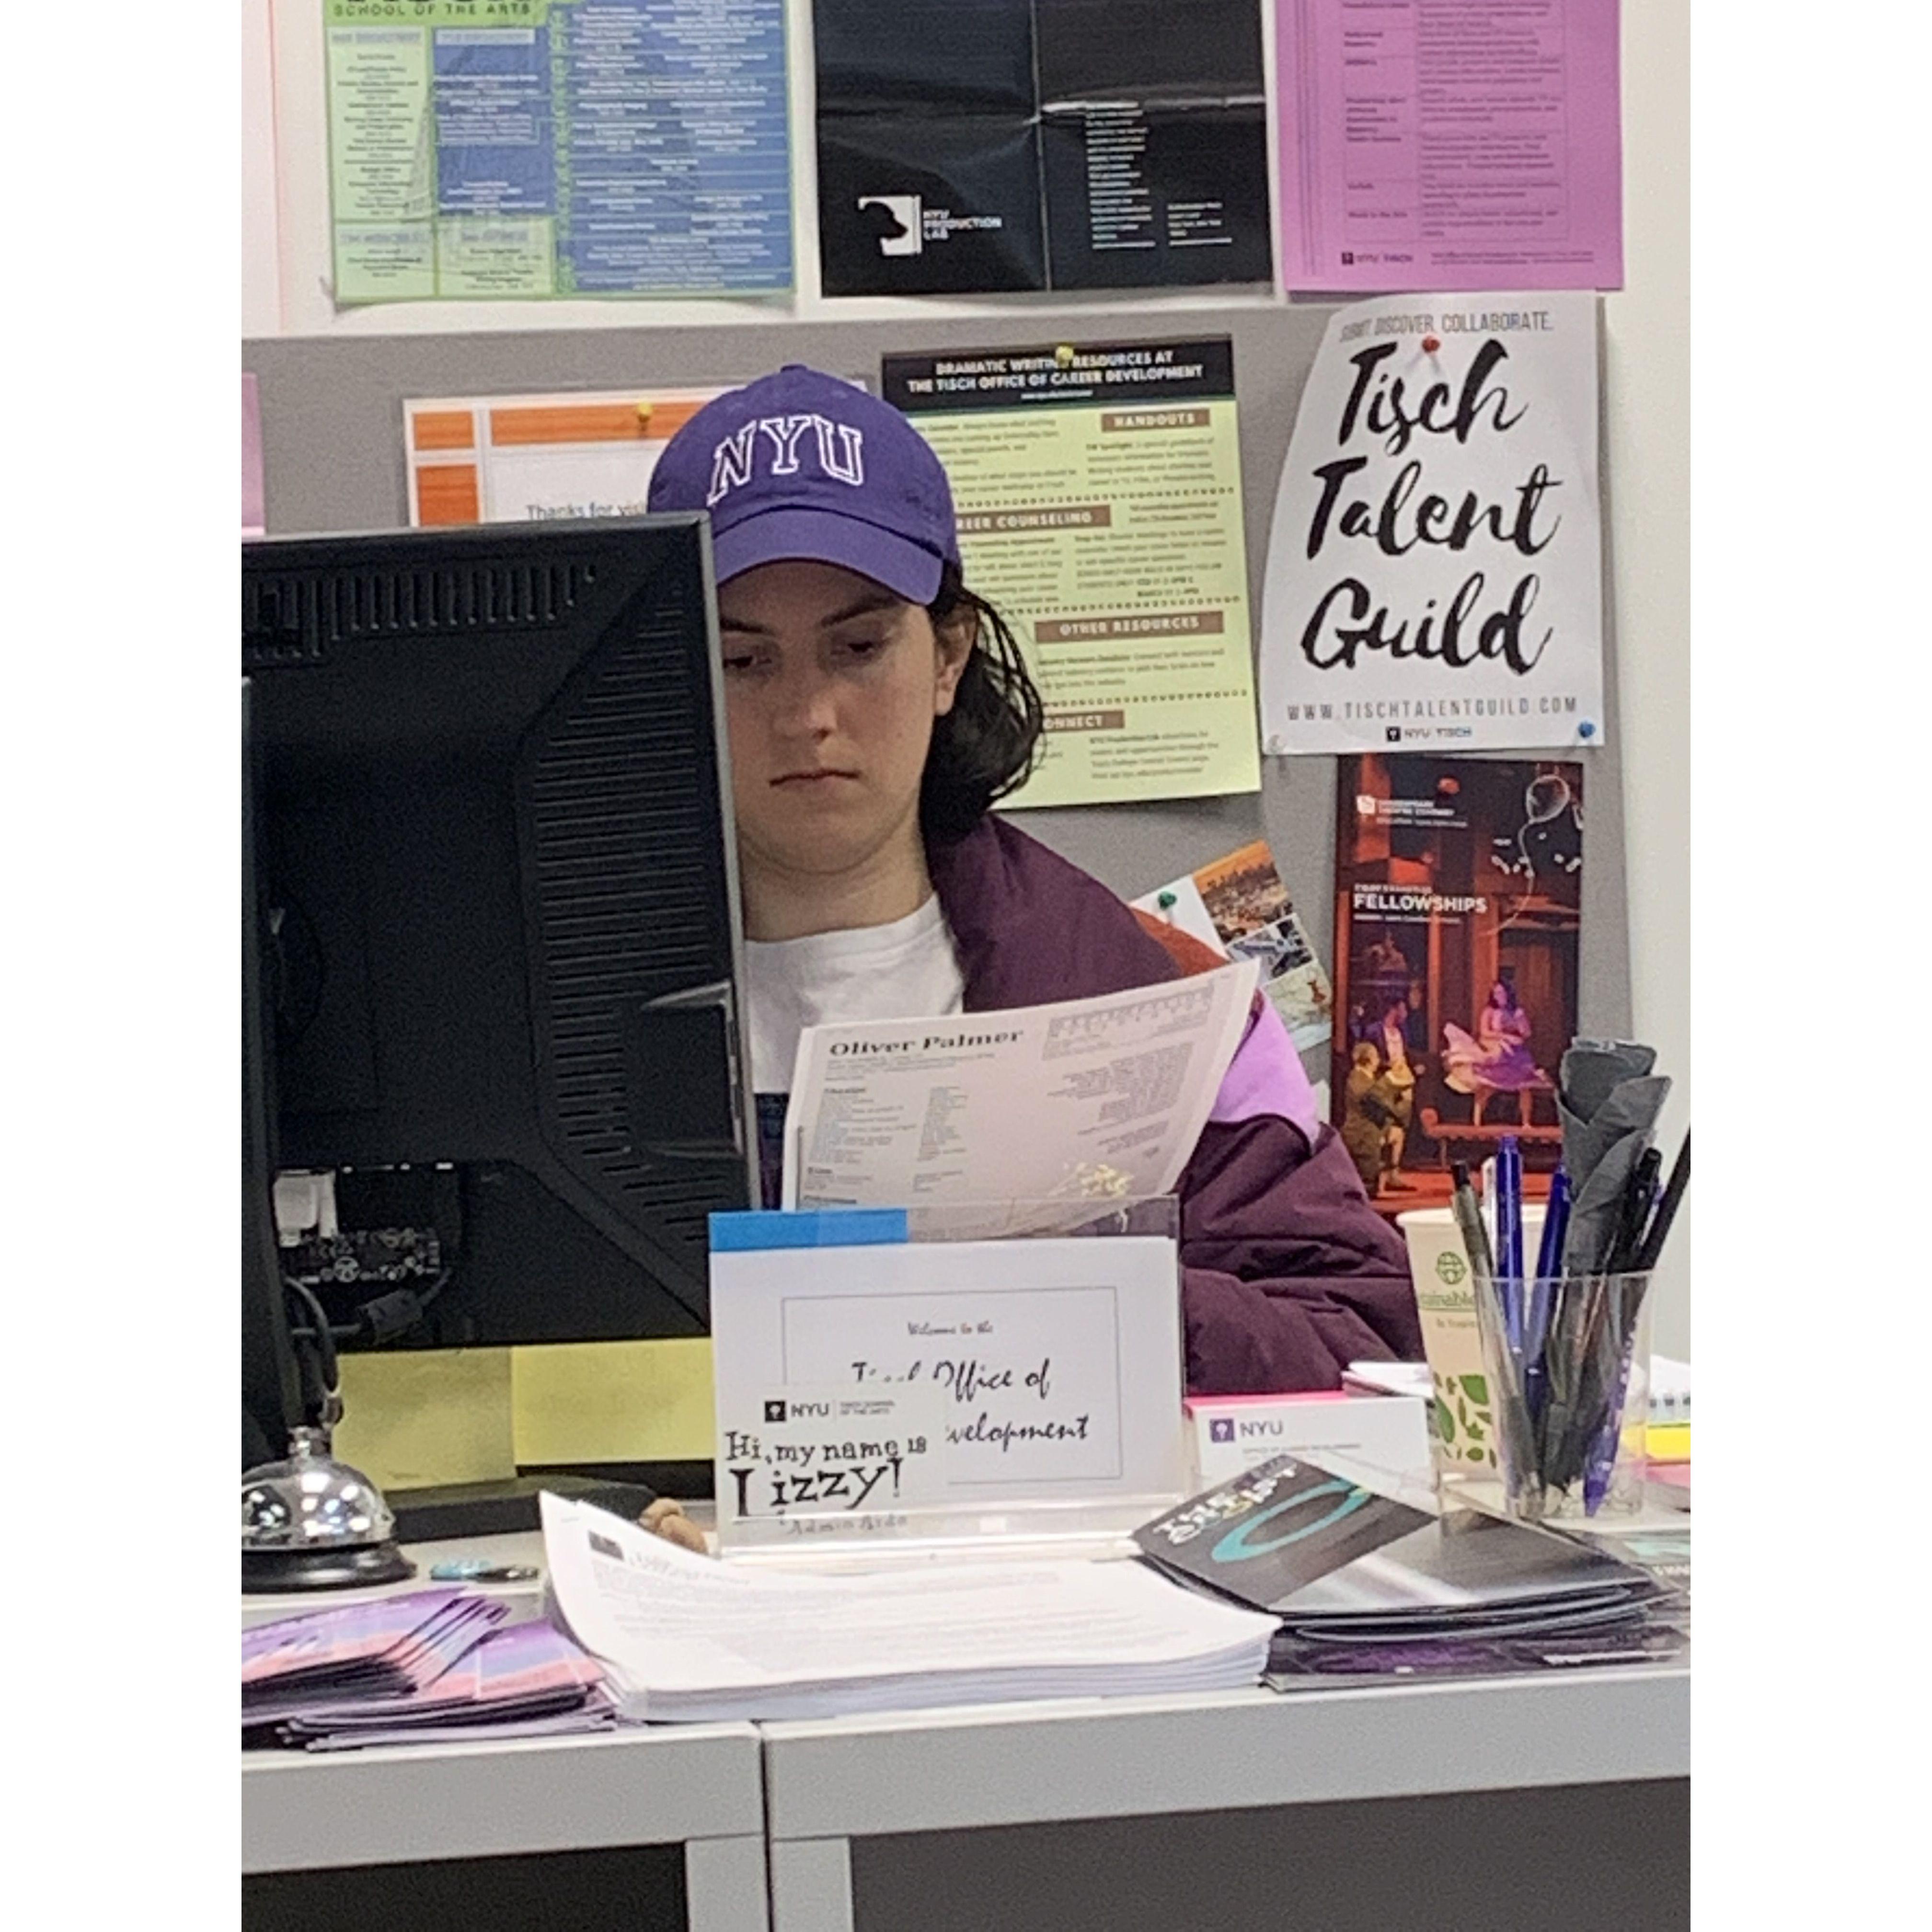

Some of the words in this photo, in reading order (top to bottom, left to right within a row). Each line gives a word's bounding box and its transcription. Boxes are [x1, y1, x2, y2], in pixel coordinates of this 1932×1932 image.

[335, 4, 405, 17] SCHOOL
[415, 4, 436, 15] OF
[446, 3, 477, 15] THE
[486, 2, 531, 15] ARTS
[936, 360, 1007, 376] DRAMATIC
[1072, 352, 1151, 368] RESOURCES
[1155, 350, 1173, 364] AT
[907, 378, 933, 392] THE
[936, 376, 976, 391] TISCH
[978, 374, 1025, 389] OFFICE
[1028, 373, 1047, 386] OF
[1050, 370, 1103, 385] CAREER
[1105, 363, 1204, 382] DEVELOPMENT
[1338, 338, 1529, 456] Tisch
[1114, 413, 1196, 427] HANDOUTS
[706, 413, 863, 506] NYU
[526, 503, 586, 521] Thanks
[589, 501, 614, 518] for
[1306, 456, 1564, 560] Talent
[955, 517, 992, 530] REER
[996, 511, 1092, 528] COUNSELING
[1060, 622, 1108, 636] OTHER
[1113, 616, 1200, 632] RESOURCES
[1300, 571, 1554, 675] Guild
[1043, 715, 1103, 730] ONNECT
[1353, 893, 1488, 913] FELLOWSHIPS
[829, 1040, 916, 1057] Oliver
[922, 1030, 1024, 1051] Palmer
[932, 1359, 1012, 1403] Office
[1024, 1357, 1051, 1400] of
[791, 1403, 830, 1417] NYU
[945, 1412, 1089, 1453] velopment
[1239, 1420, 1284, 1436] NYU
[822, 1438, 899, 1462] name
